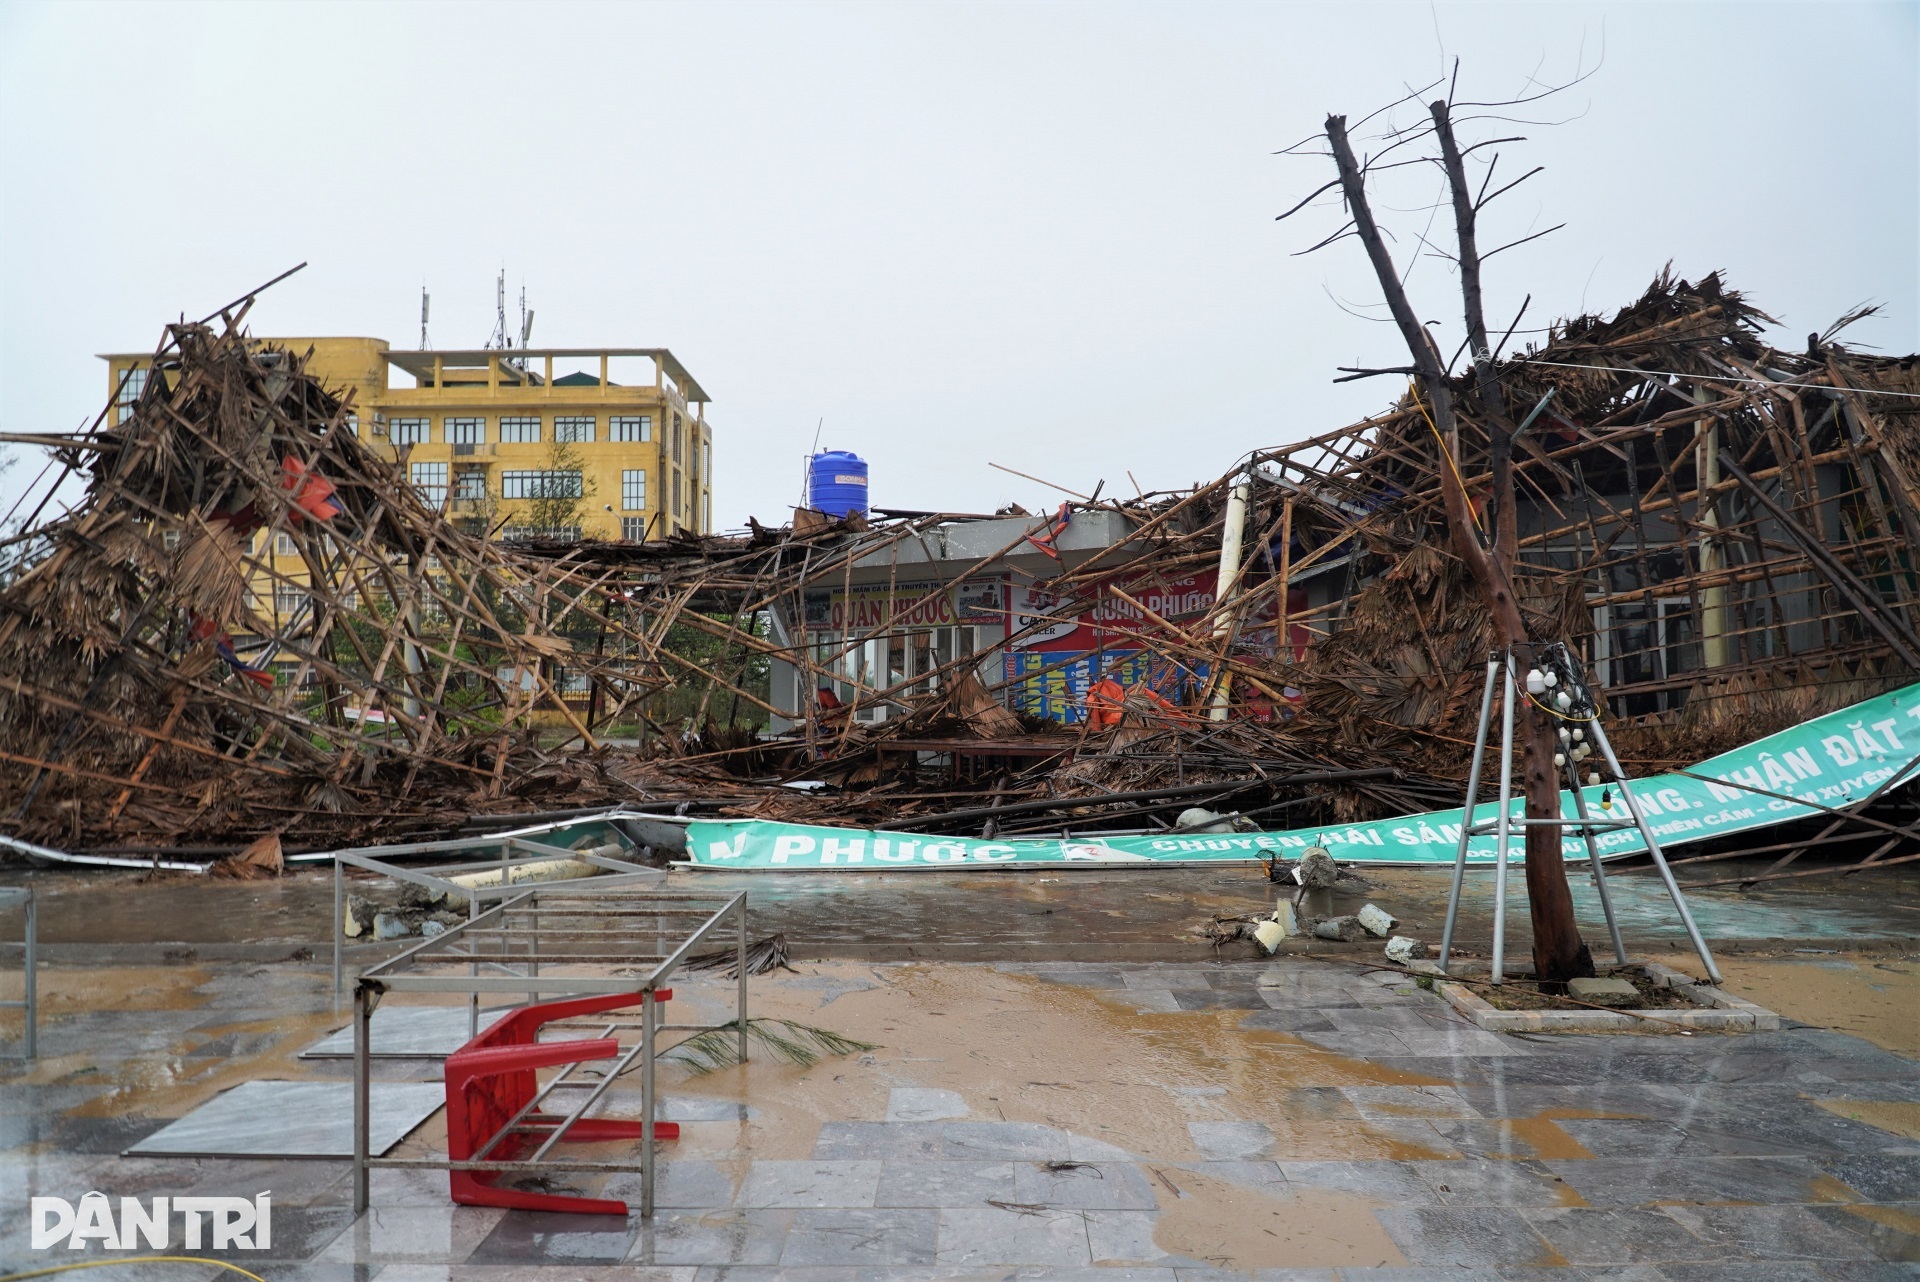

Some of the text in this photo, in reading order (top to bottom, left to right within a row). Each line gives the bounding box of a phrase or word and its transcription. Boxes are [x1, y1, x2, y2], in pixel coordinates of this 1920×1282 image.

[1152, 832, 1306, 851] CHUYÊN
[1316, 827, 1385, 846] HẢI
[1392, 820, 1472, 846] SẢN
[1703, 746, 1823, 804] NHẬN
[1820, 718, 1905, 768] ĐẶT
[1817, 766, 1897, 800] XUYÊN
[771, 835, 1017, 864] PHƯỚC
